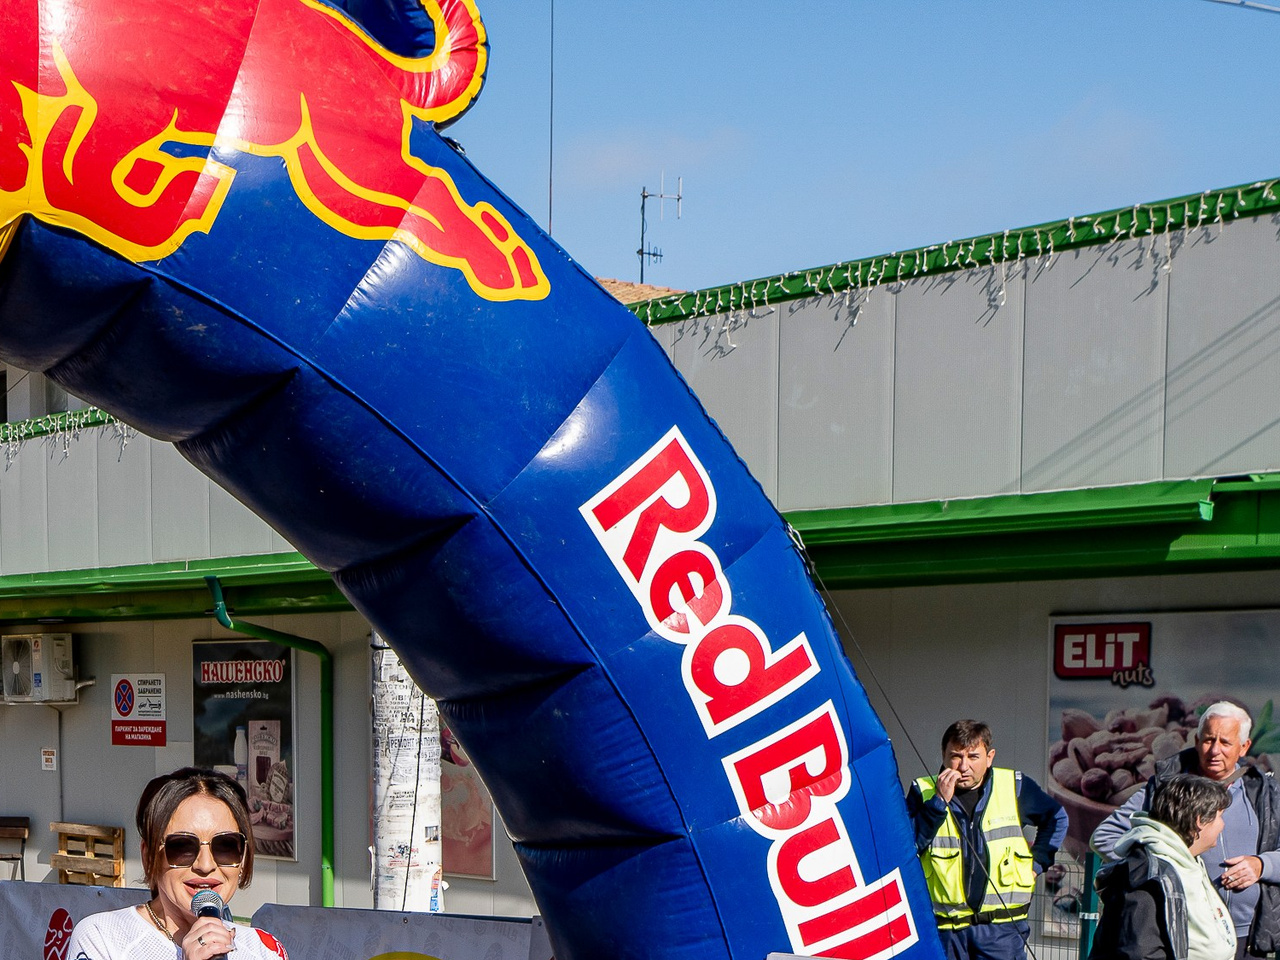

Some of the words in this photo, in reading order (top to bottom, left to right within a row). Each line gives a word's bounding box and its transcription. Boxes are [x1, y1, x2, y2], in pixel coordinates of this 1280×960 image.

[588, 436, 814, 728] Red
[201, 660, 284, 683] НАШЕНСКО
[1112, 661, 1154, 687] nuts
